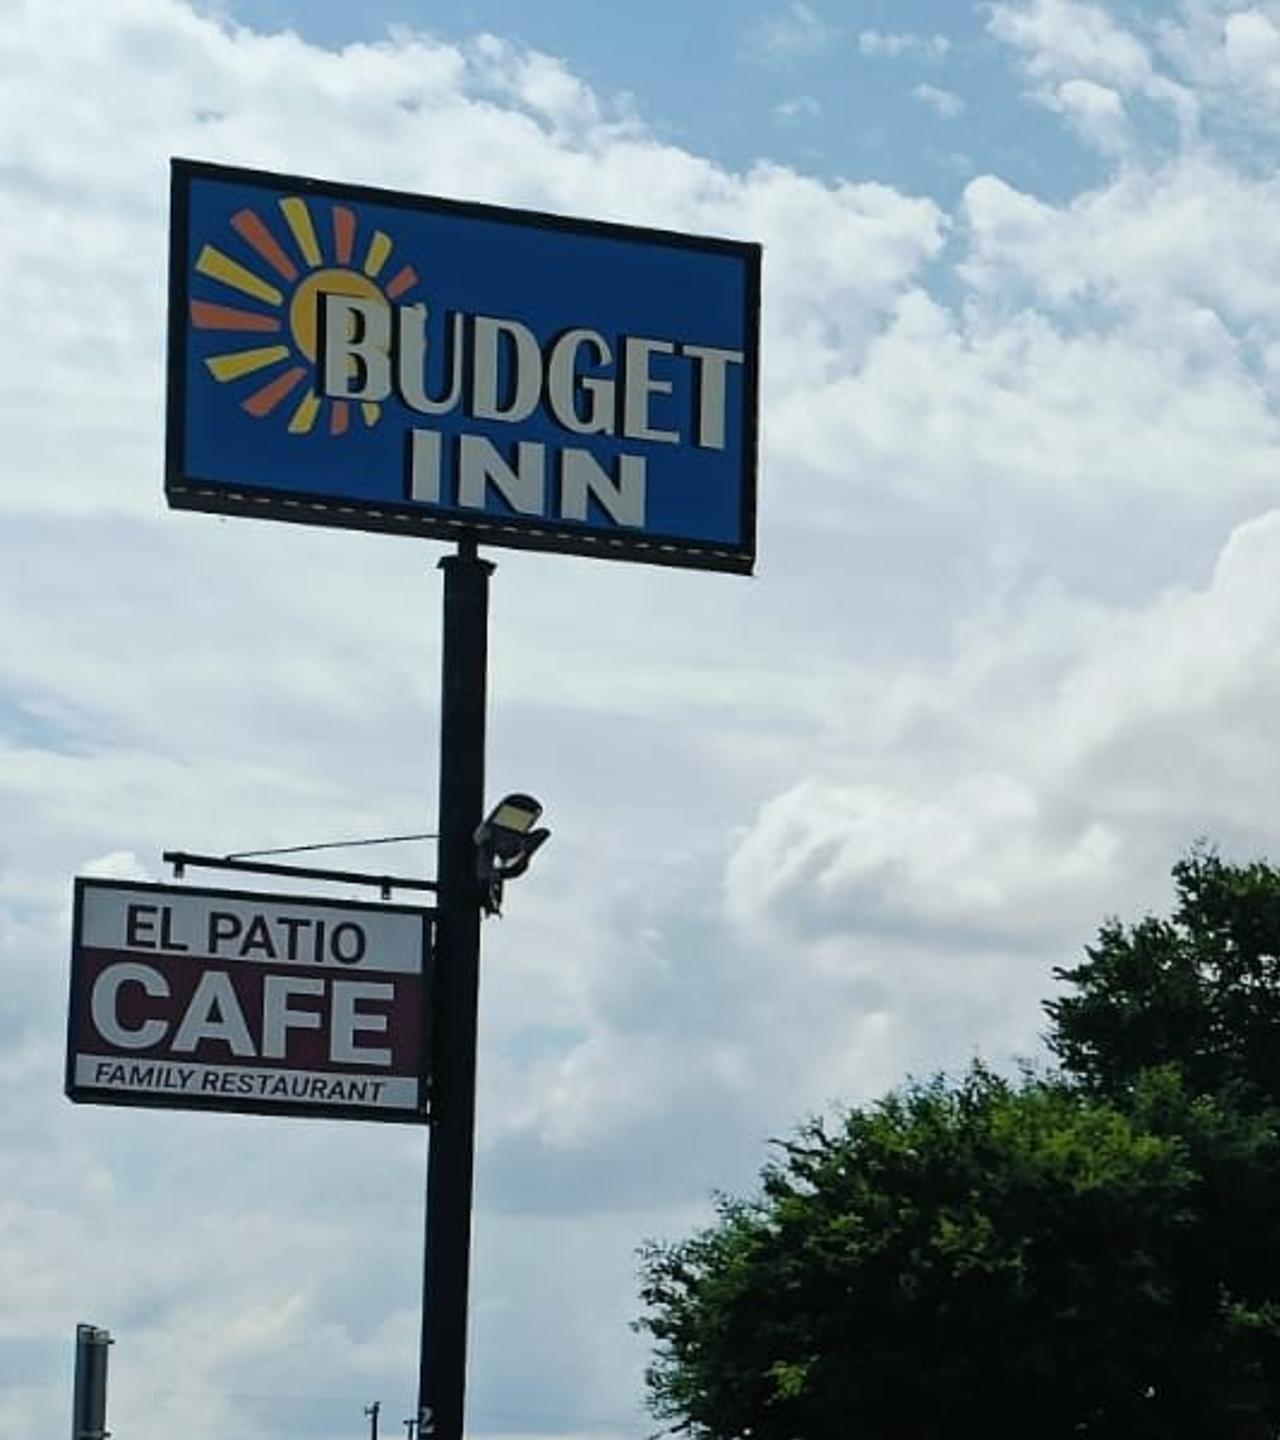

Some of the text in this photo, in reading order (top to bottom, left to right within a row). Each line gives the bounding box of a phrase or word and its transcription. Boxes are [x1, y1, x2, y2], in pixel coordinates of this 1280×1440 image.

[323, 293, 744, 451] BUDGET
[411, 429, 646, 528] INN
[126, 904, 366, 964] EL PATIO
[91, 962, 394, 1066] CAFE
[95, 1063, 385, 1102] FAMILY RESTAURANT
